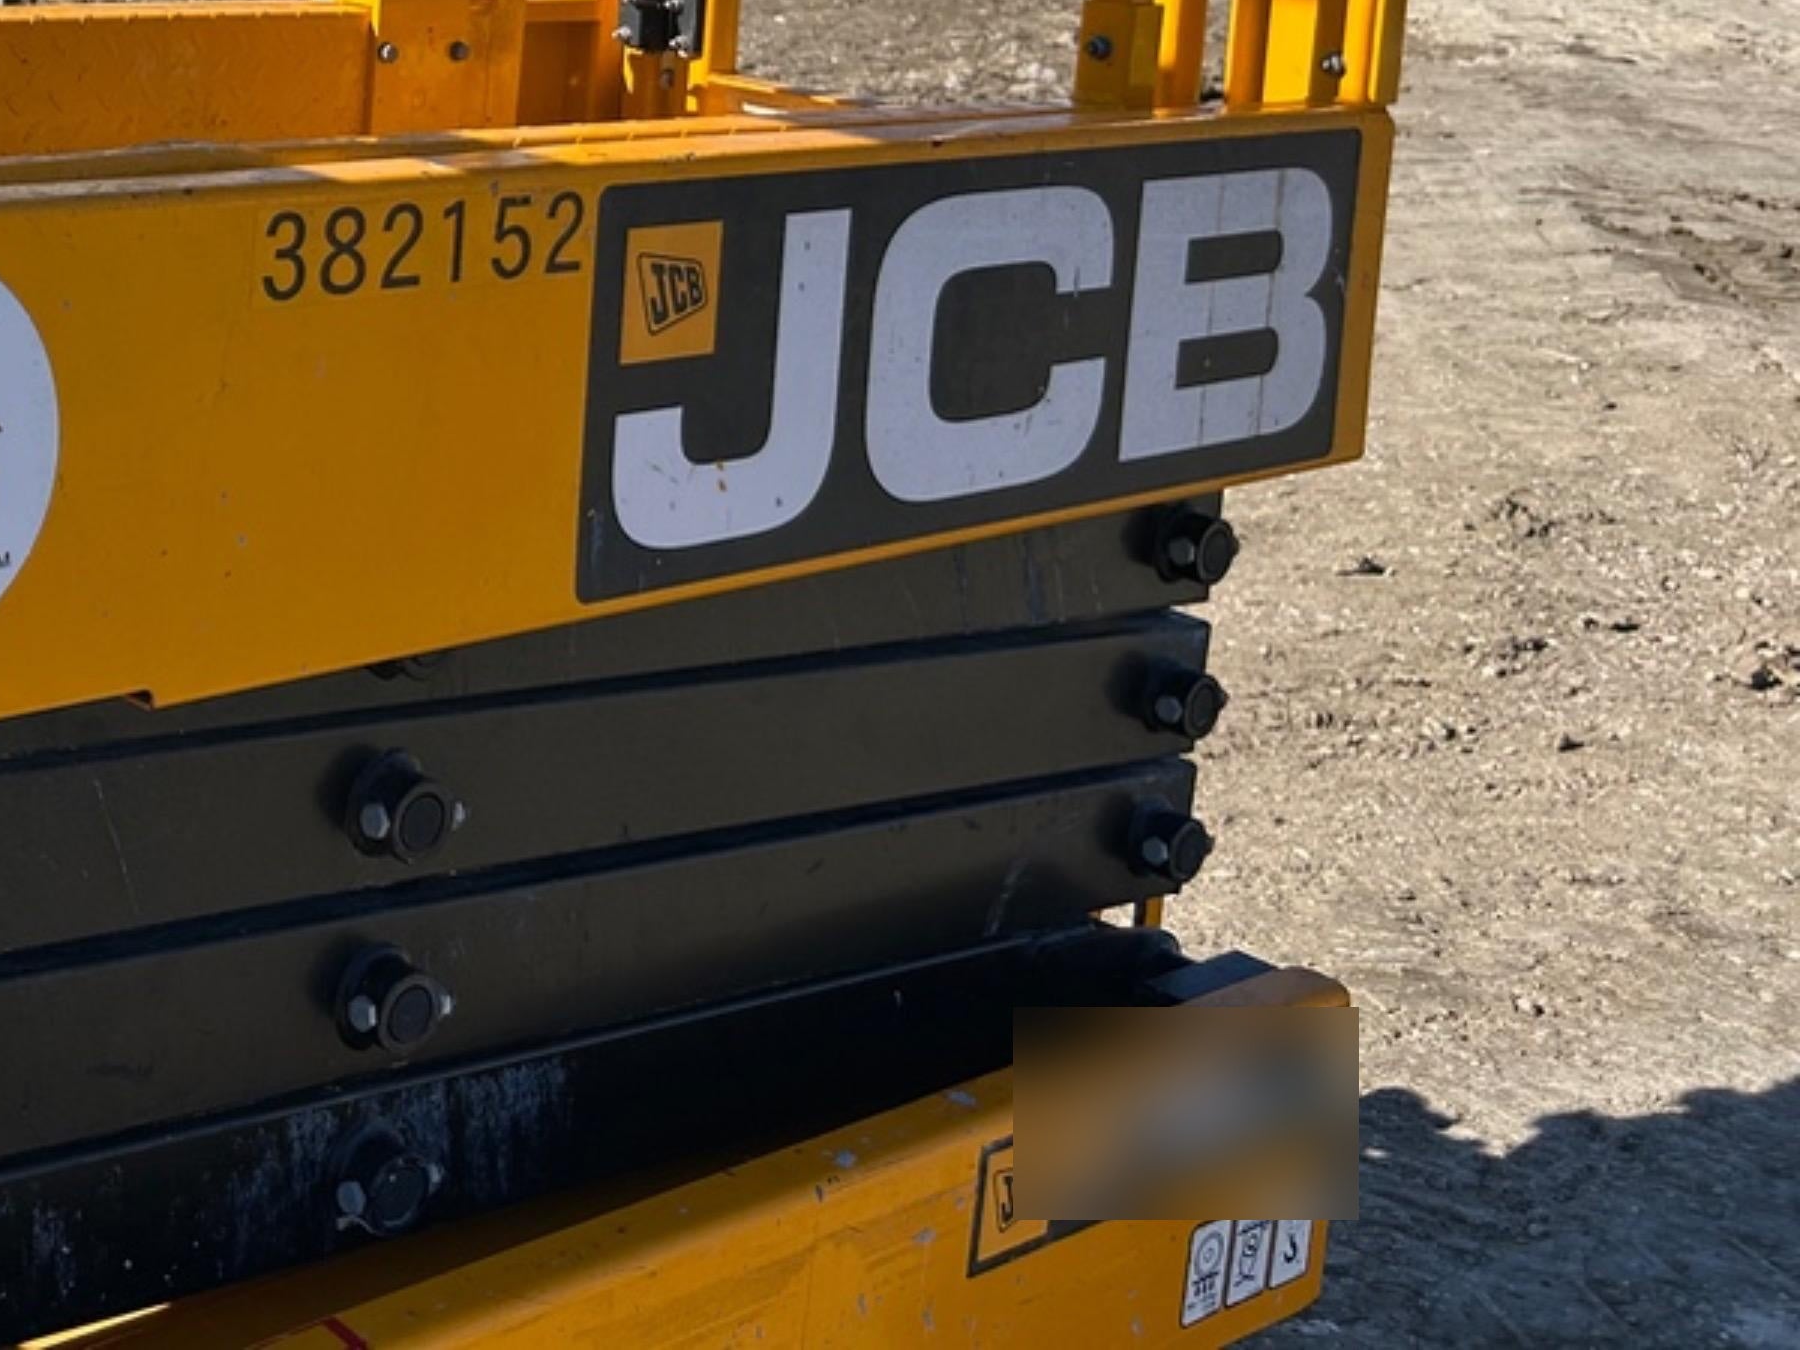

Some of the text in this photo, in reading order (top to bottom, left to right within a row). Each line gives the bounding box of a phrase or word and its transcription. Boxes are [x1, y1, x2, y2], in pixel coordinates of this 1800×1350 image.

[262, 191, 584, 302] 382152
[650, 262, 703, 325] JCB
[612, 167, 1333, 550] JCB
